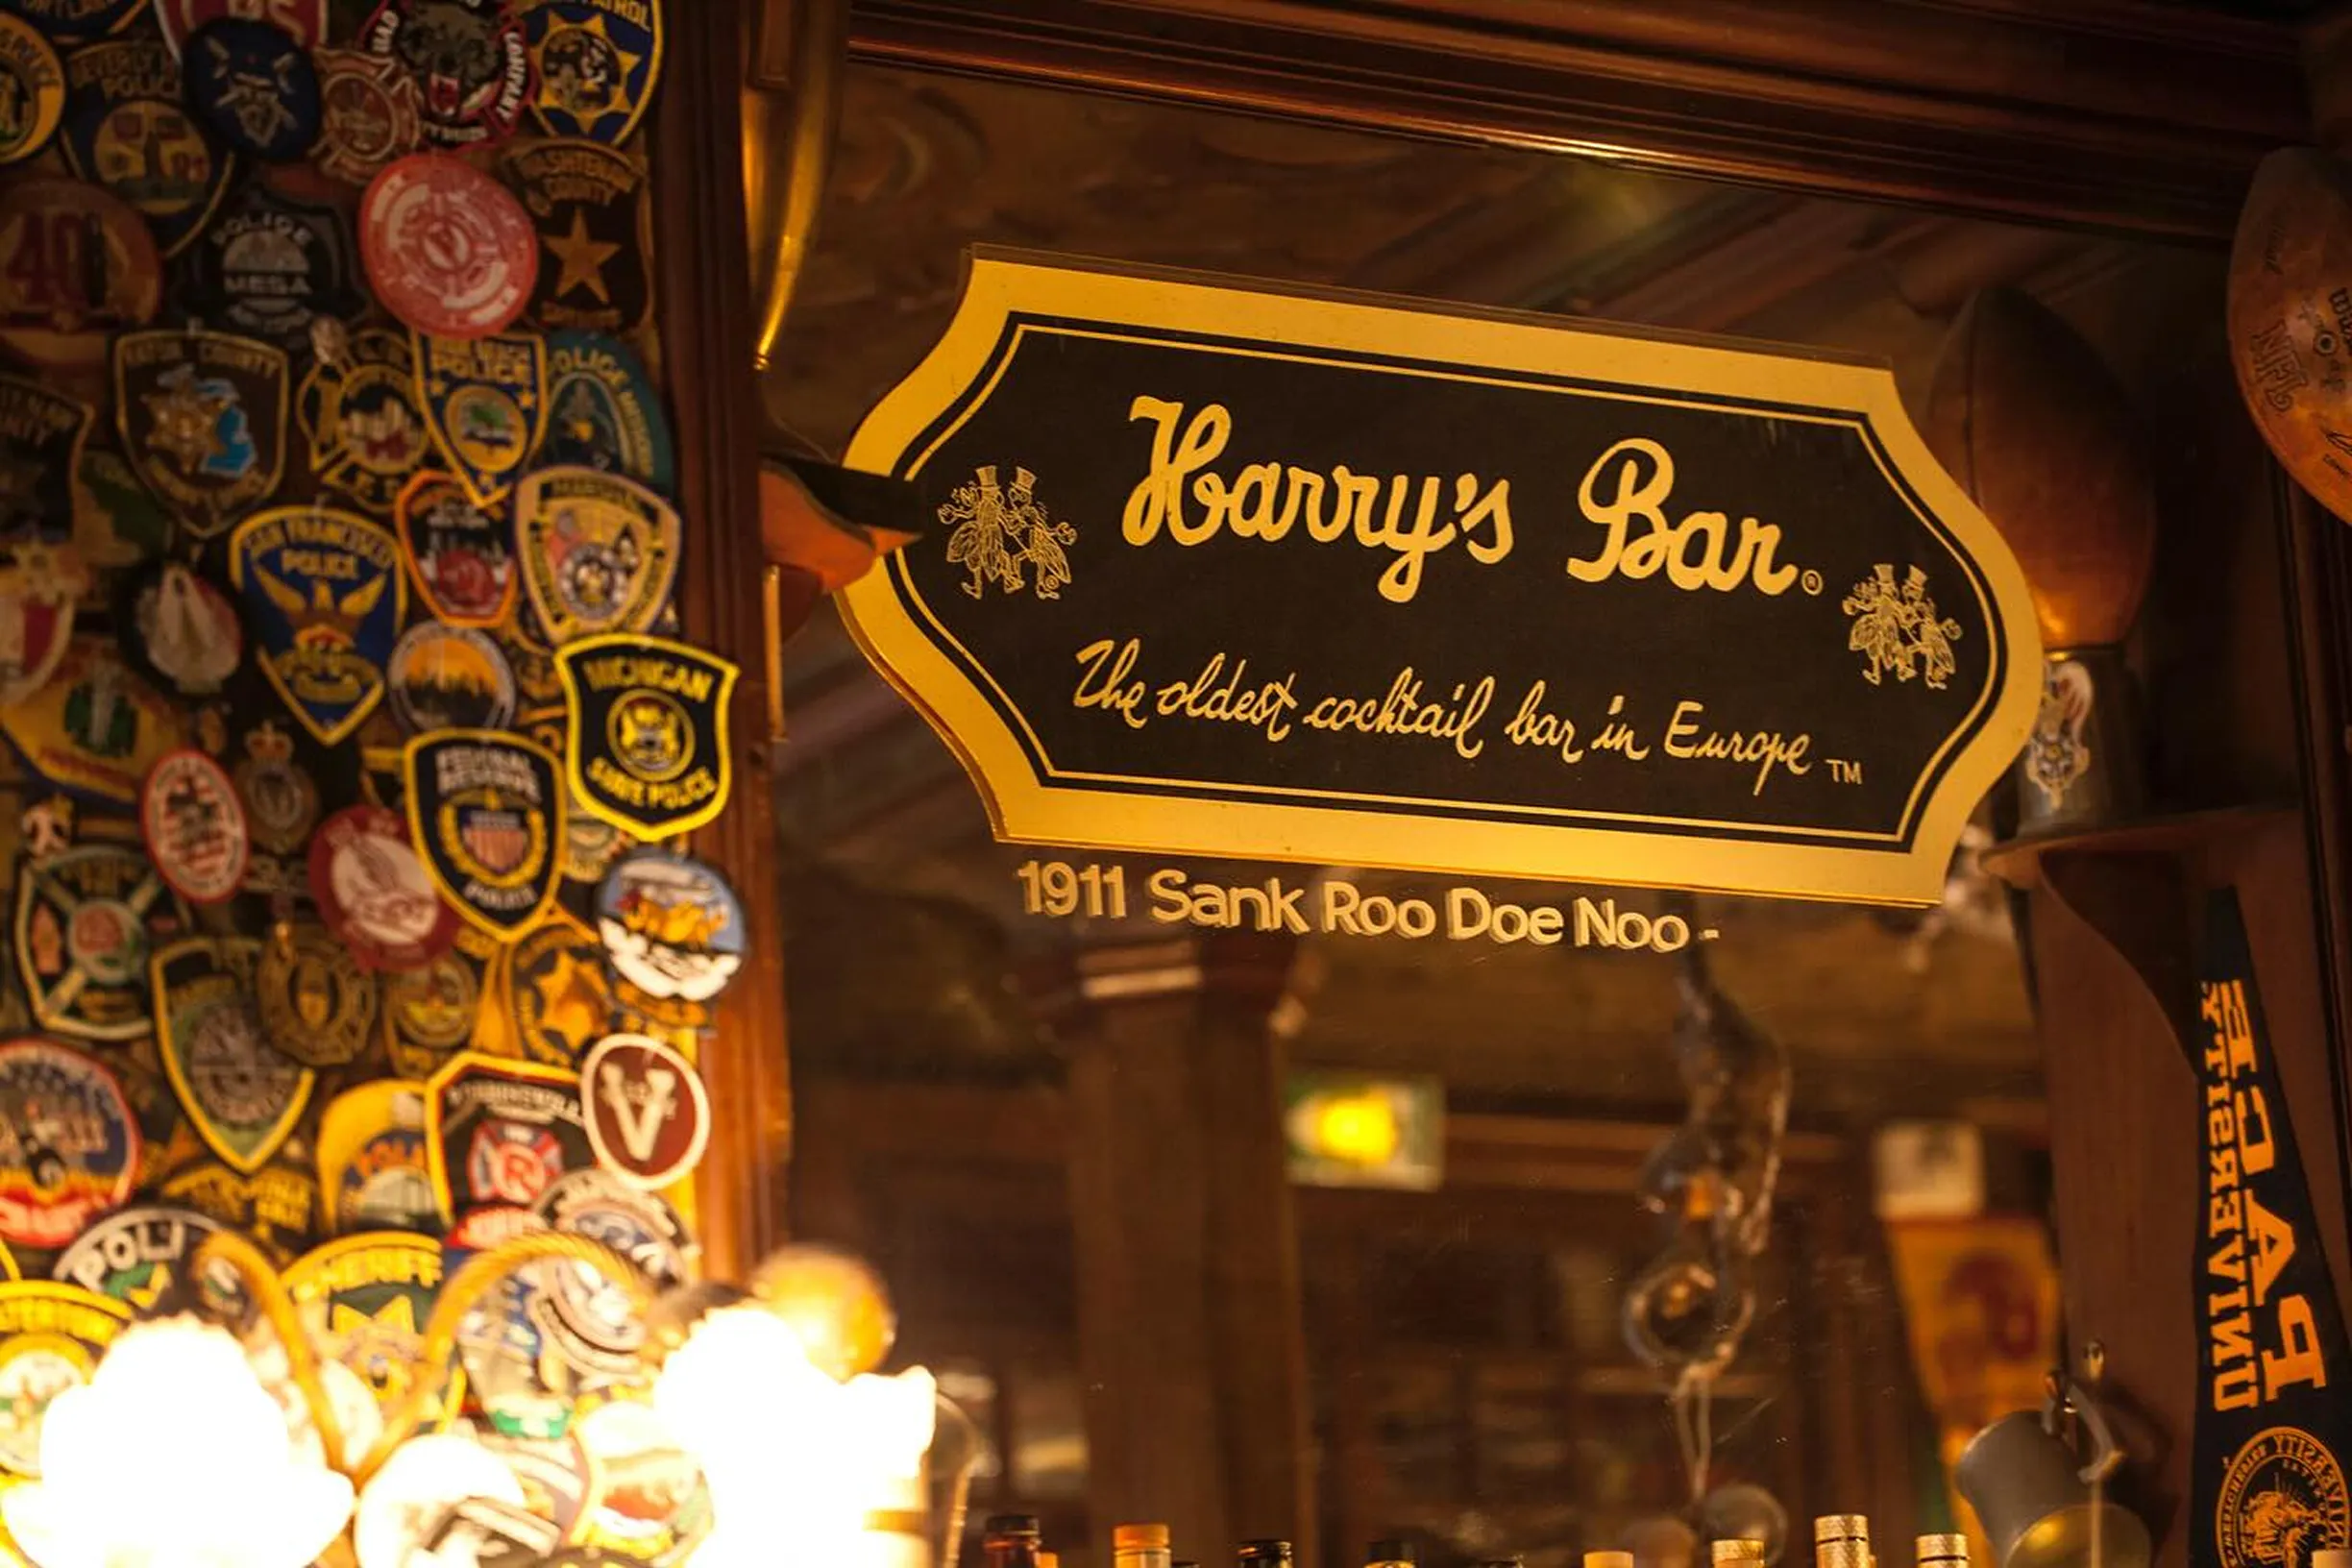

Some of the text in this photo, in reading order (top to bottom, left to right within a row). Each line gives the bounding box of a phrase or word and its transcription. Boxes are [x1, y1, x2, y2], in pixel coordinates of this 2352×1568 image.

[2252, 317, 2308, 412] NFL
[1122, 395, 1514, 603] Harry's
[281, 548, 359, 579] POLICE
[582, 656, 716, 703] MICHIGAN
[1072, 638, 1149, 729] The
[1156, 652, 1300, 743] oldest
[1302, 666, 1497, 759] cocktail
[1504, 679, 1585, 764] bar
[1590, 695, 1650, 761] in
[1663, 700, 1813, 796] Europe
[586, 757, 717, 810] STATE POLICE
[463, 881, 539, 911] POLICE
[1017, 860, 1127, 918] 1911
[1148, 869, 1311, 936] Sank
[1320, 880, 1437, 939] Roo
[1445, 887, 1565, 945] Doe
[1573, 897, 1691, 953] Noo
[73, 1221, 185, 1293] POLI
